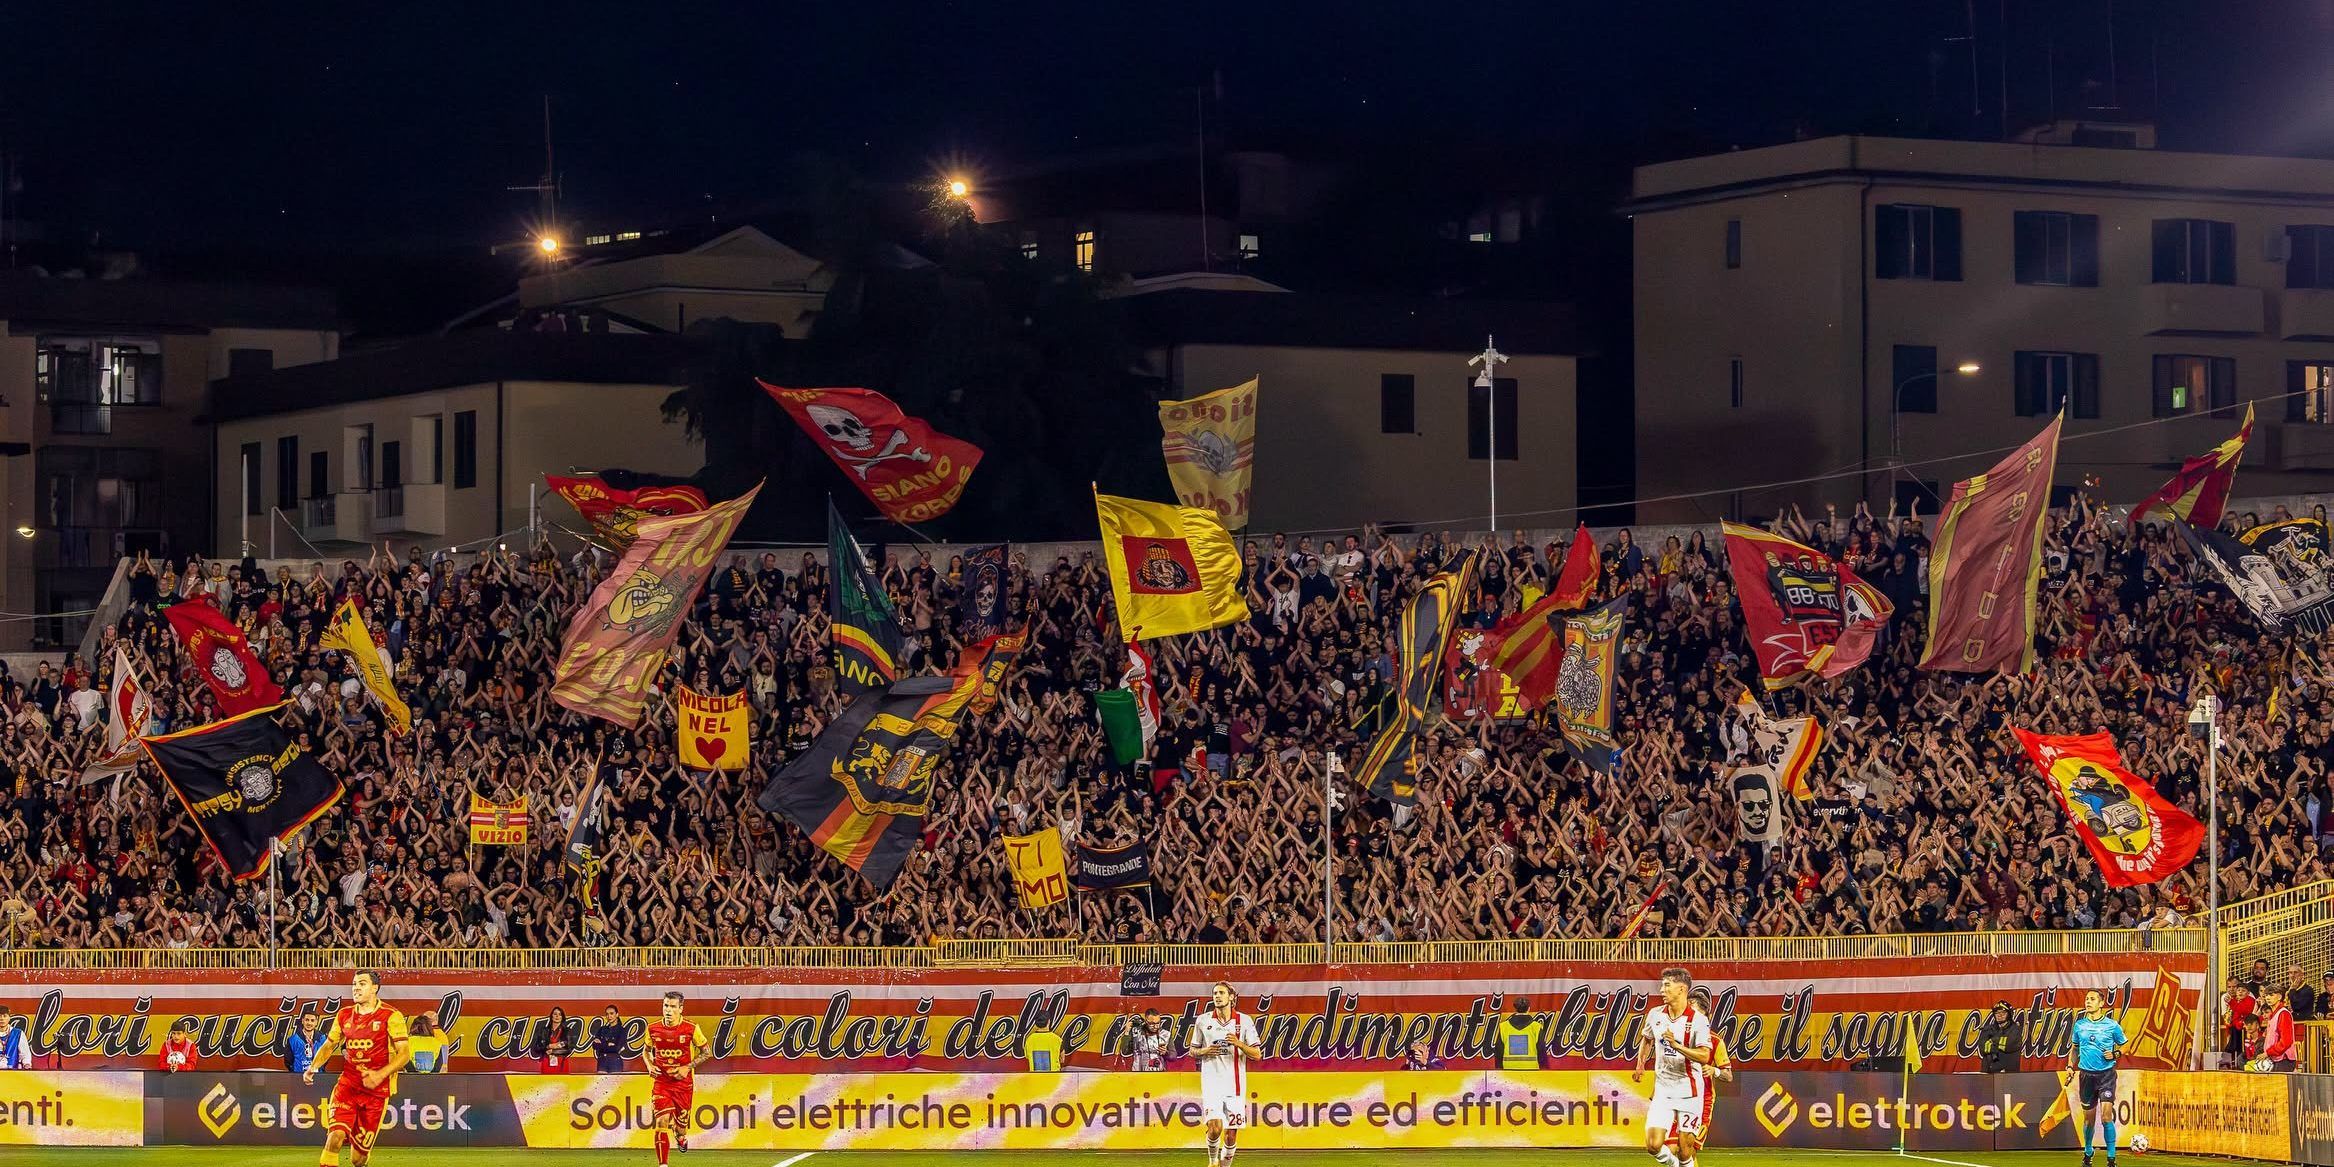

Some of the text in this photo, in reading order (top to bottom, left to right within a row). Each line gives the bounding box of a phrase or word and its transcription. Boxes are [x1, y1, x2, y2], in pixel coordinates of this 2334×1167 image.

[872, 455, 951, 501] SIANO
[680, 688, 748, 713] NICOLA
[689, 713, 731, 734] NEL
[478, 830, 522, 843] VIZIO
[1010, 840, 1044, 870] TI
[1082, 856, 1143, 877] PONTEGRANDE
[1123, 977, 1141, 990] Con
[749, 989, 935, 1060] colori
[1773, 984, 1814, 1063] il
[0, 1090, 74, 1127] nti.
[570, 1094, 757, 1131] Soluoni
[772, 1094, 972, 1129] elettriche
[987, 1093, 1201, 1128] innovative
[1244, 1092, 1351, 1127] icure
[1366, 1092, 1418, 1127] ed
[1433, 1090, 1630, 1127] efficienti.
[1228, 1113, 1242, 1127] 28
[1808, 1093, 2028, 1131] elettrotek
[1682, 1114, 1699, 1130] 24
[355, 1126, 375, 1148] 20
